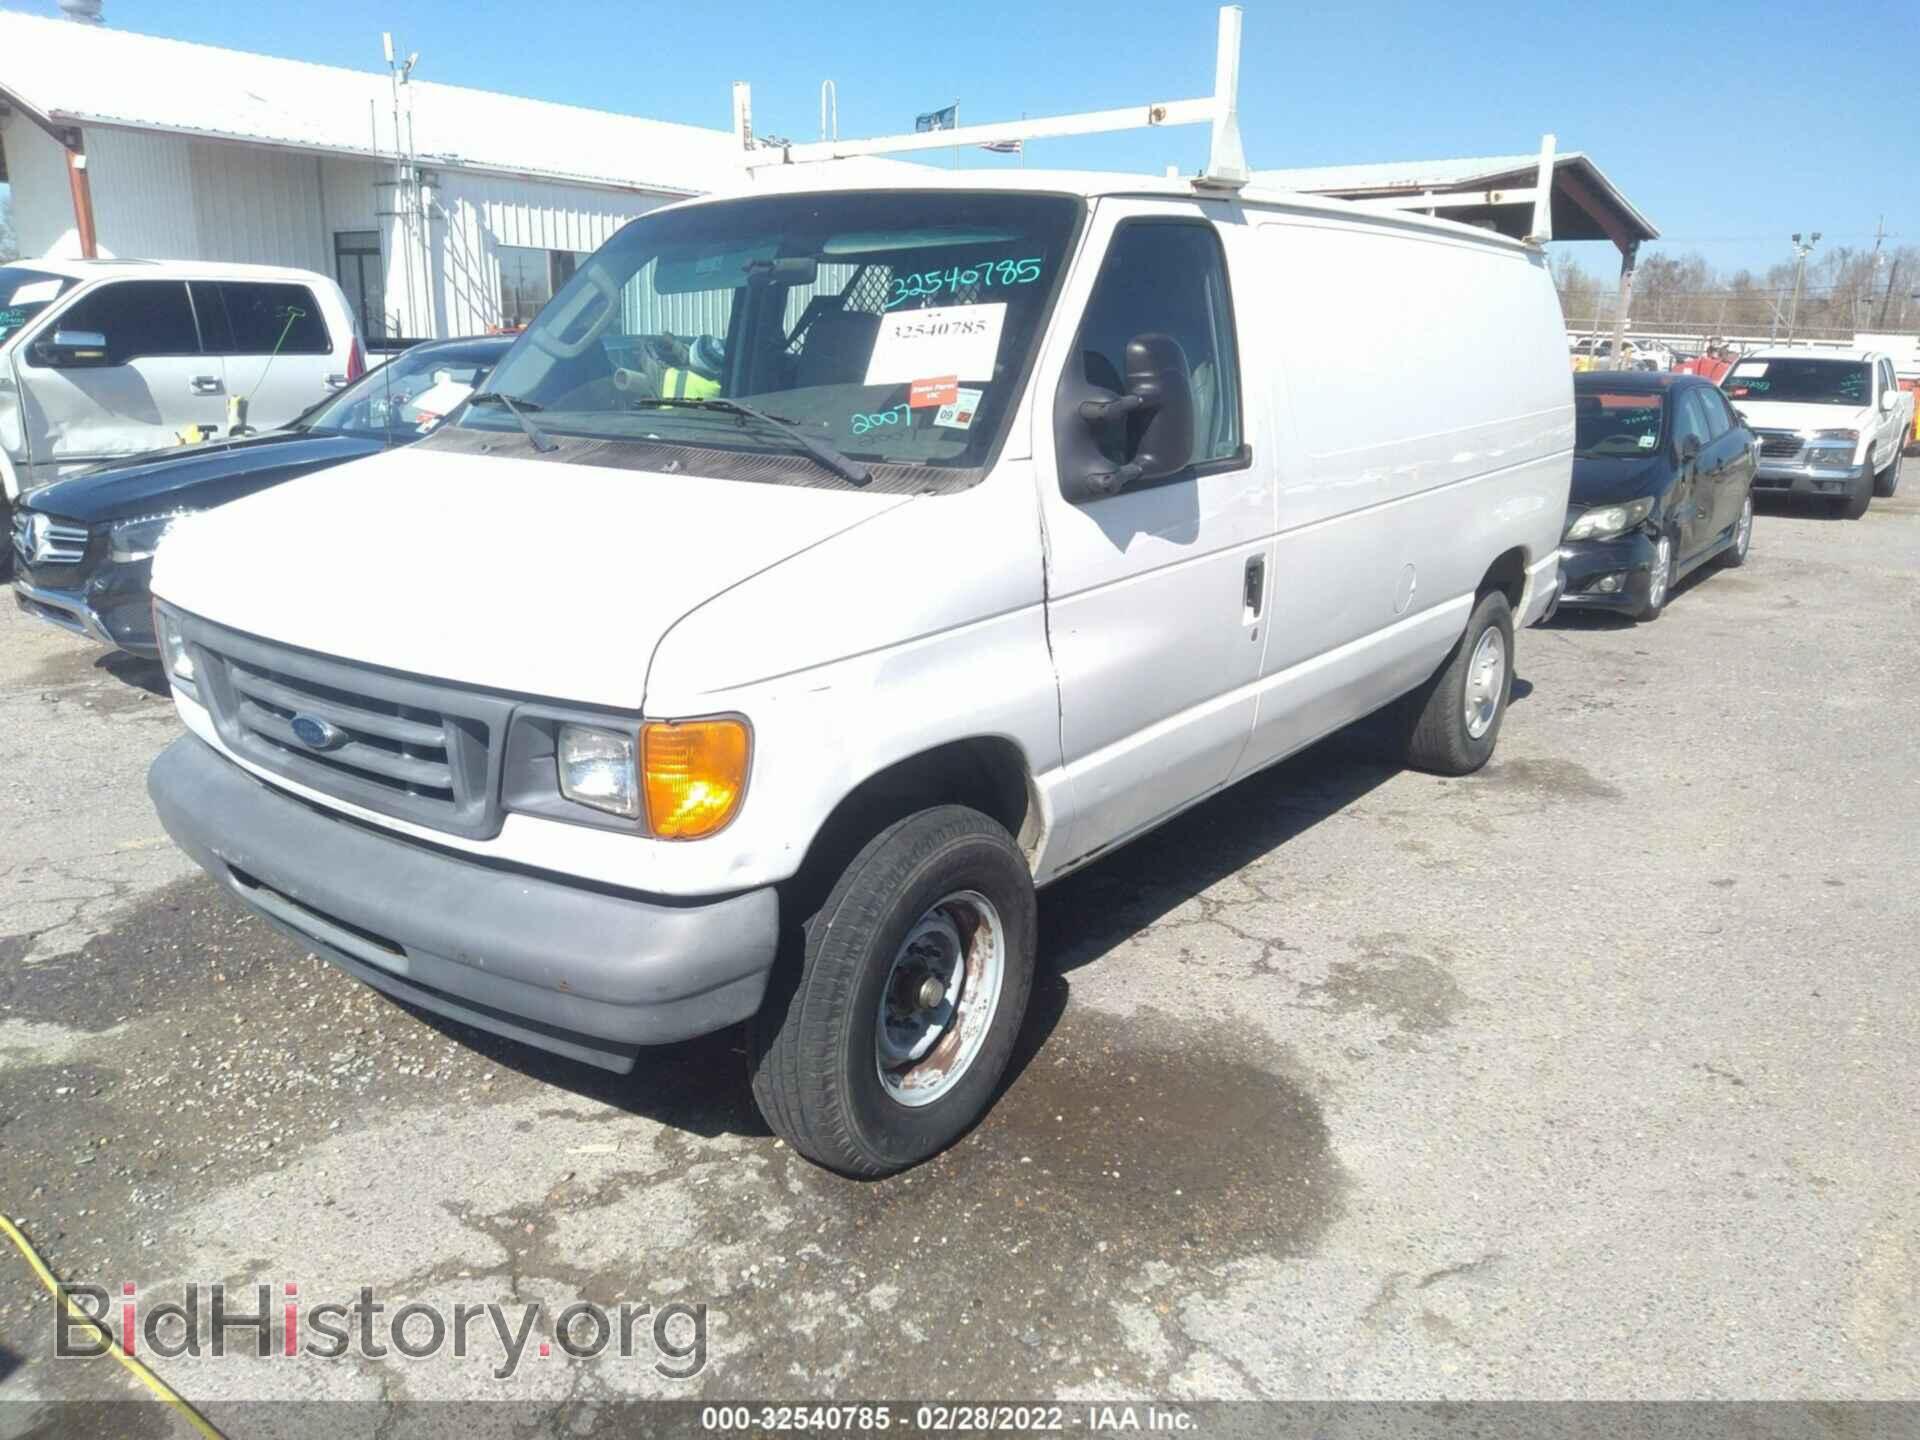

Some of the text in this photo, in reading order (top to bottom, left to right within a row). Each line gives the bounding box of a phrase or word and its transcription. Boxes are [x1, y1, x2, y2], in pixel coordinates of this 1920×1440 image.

[884, 258, 1042, 308] 32540785
[895, 319, 987, 338] 32540785
[851, 403, 912, 434] 2007
